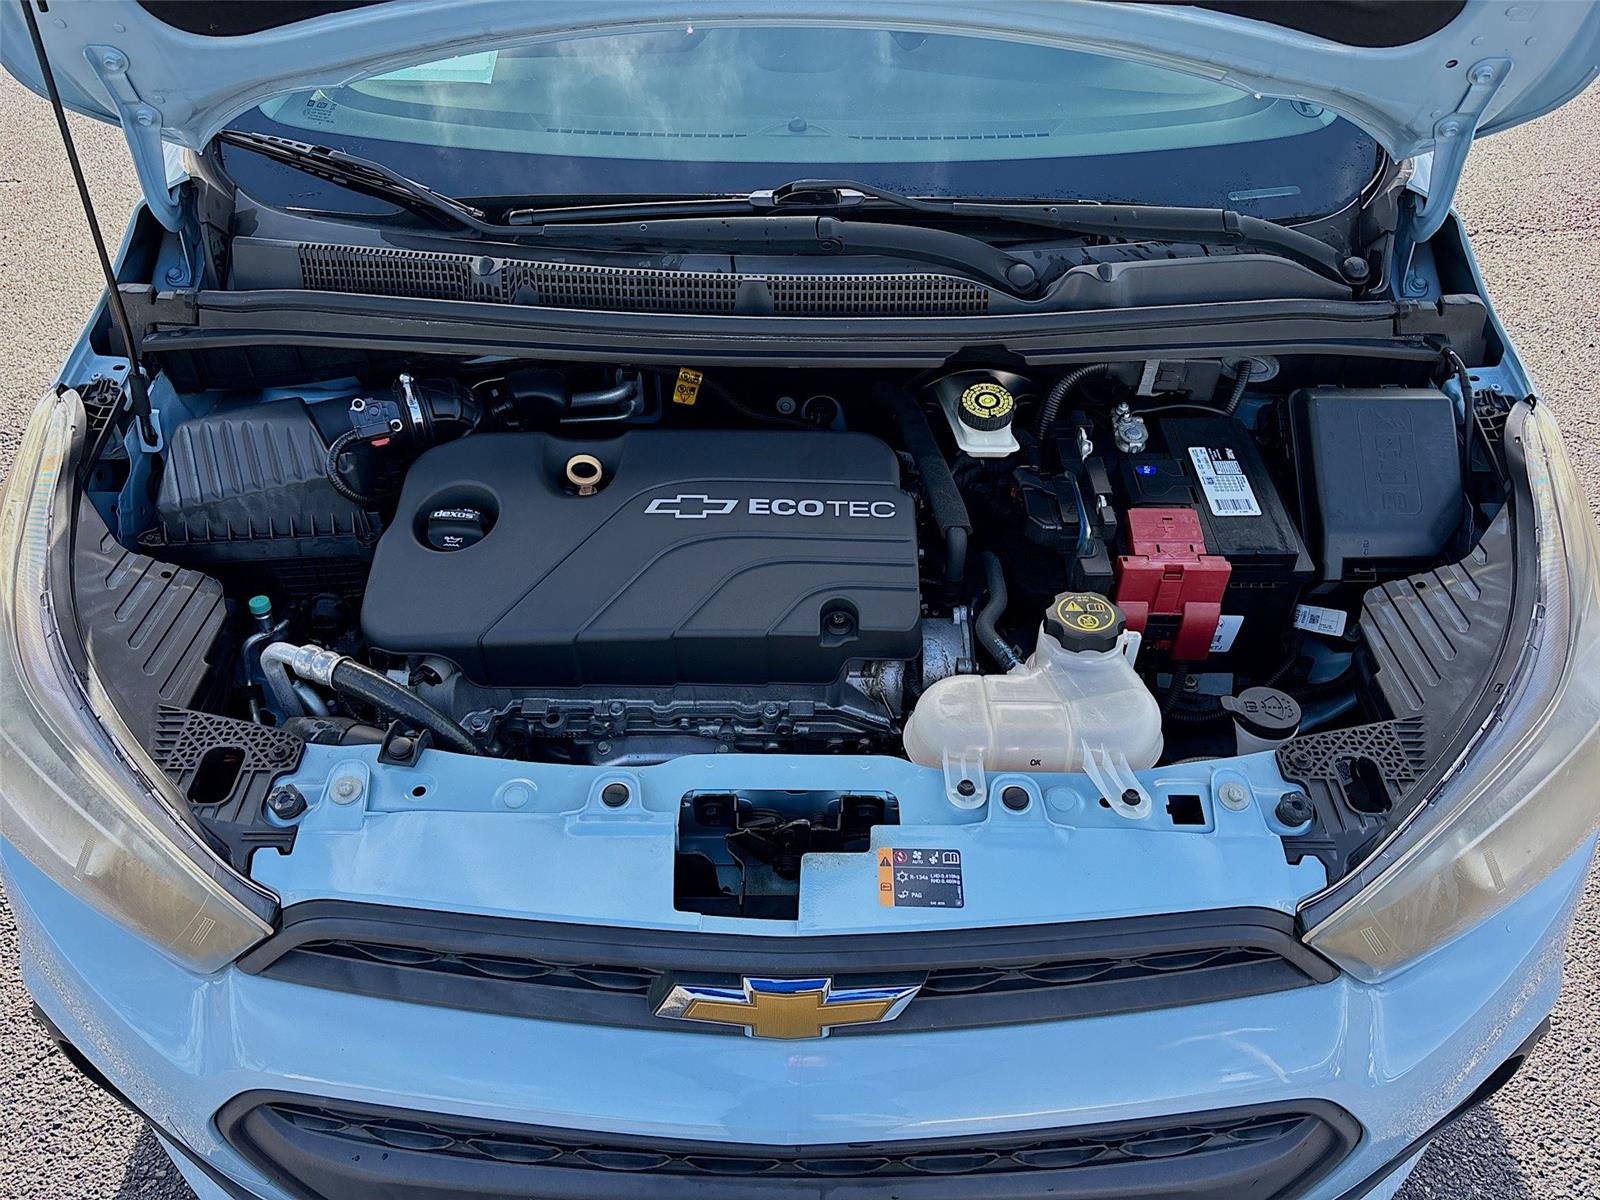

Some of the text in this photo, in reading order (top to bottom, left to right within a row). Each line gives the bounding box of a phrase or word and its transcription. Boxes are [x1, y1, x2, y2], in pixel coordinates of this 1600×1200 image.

[748, 498, 896, 518] ECOTEC
[433, 509, 475, 519] dexos
[1030, 758, 1041, 767] OK
